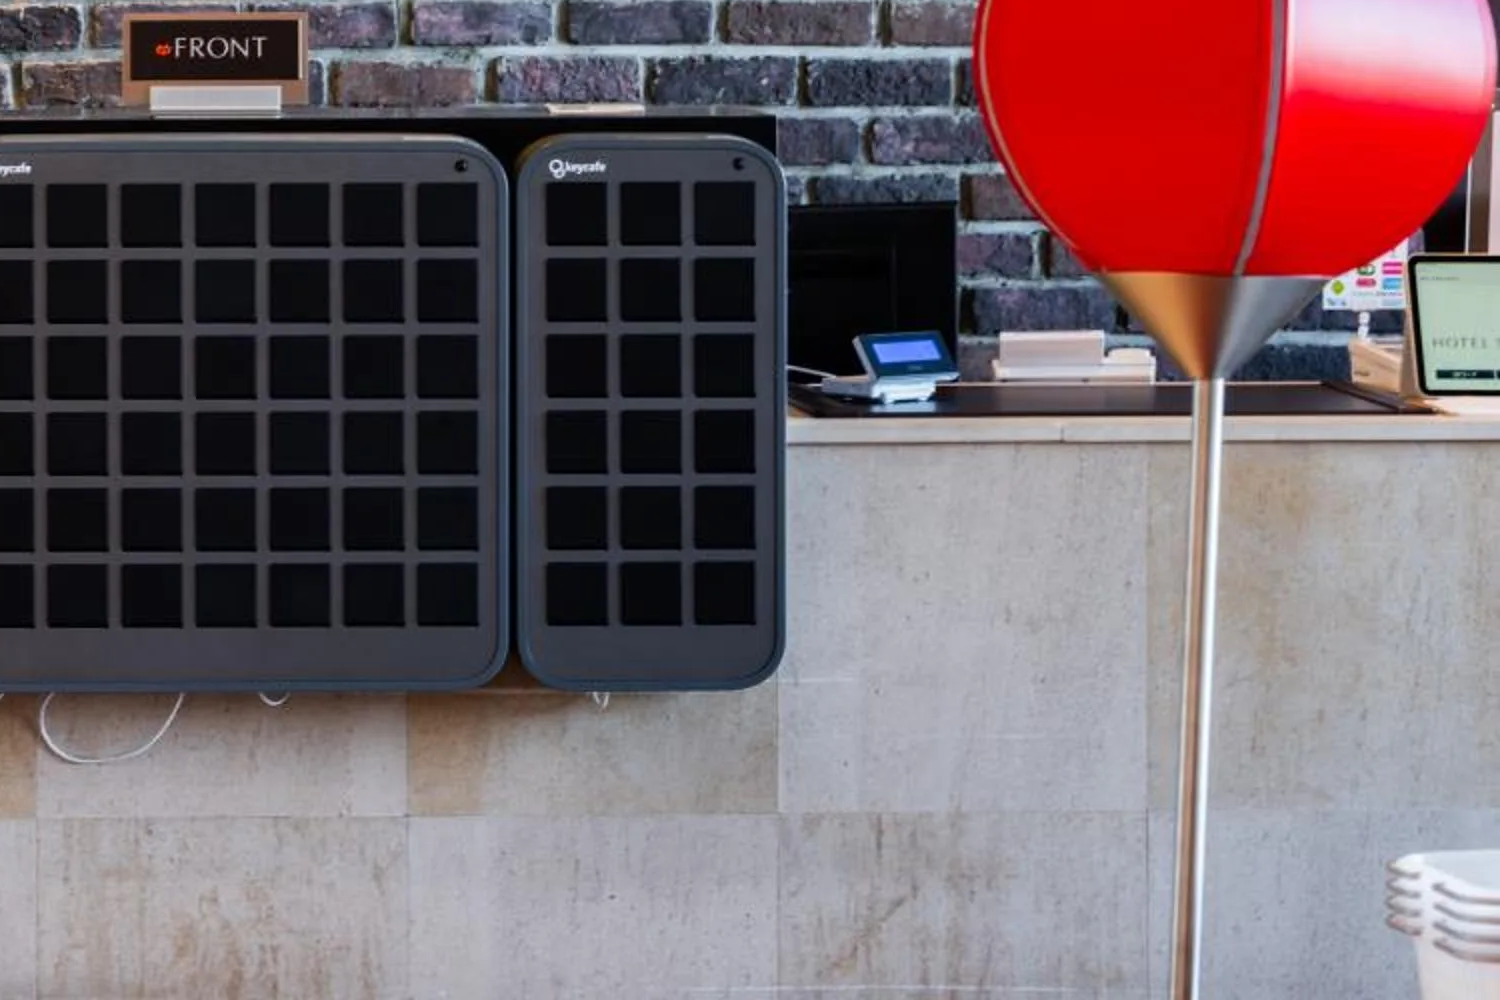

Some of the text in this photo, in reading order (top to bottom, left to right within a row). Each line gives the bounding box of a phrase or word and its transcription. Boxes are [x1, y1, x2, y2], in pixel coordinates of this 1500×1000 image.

[174, 36, 268, 60] FRONT
[565, 160, 607, 175] keycafe
[1431, 337, 1488, 350] HOTEL
